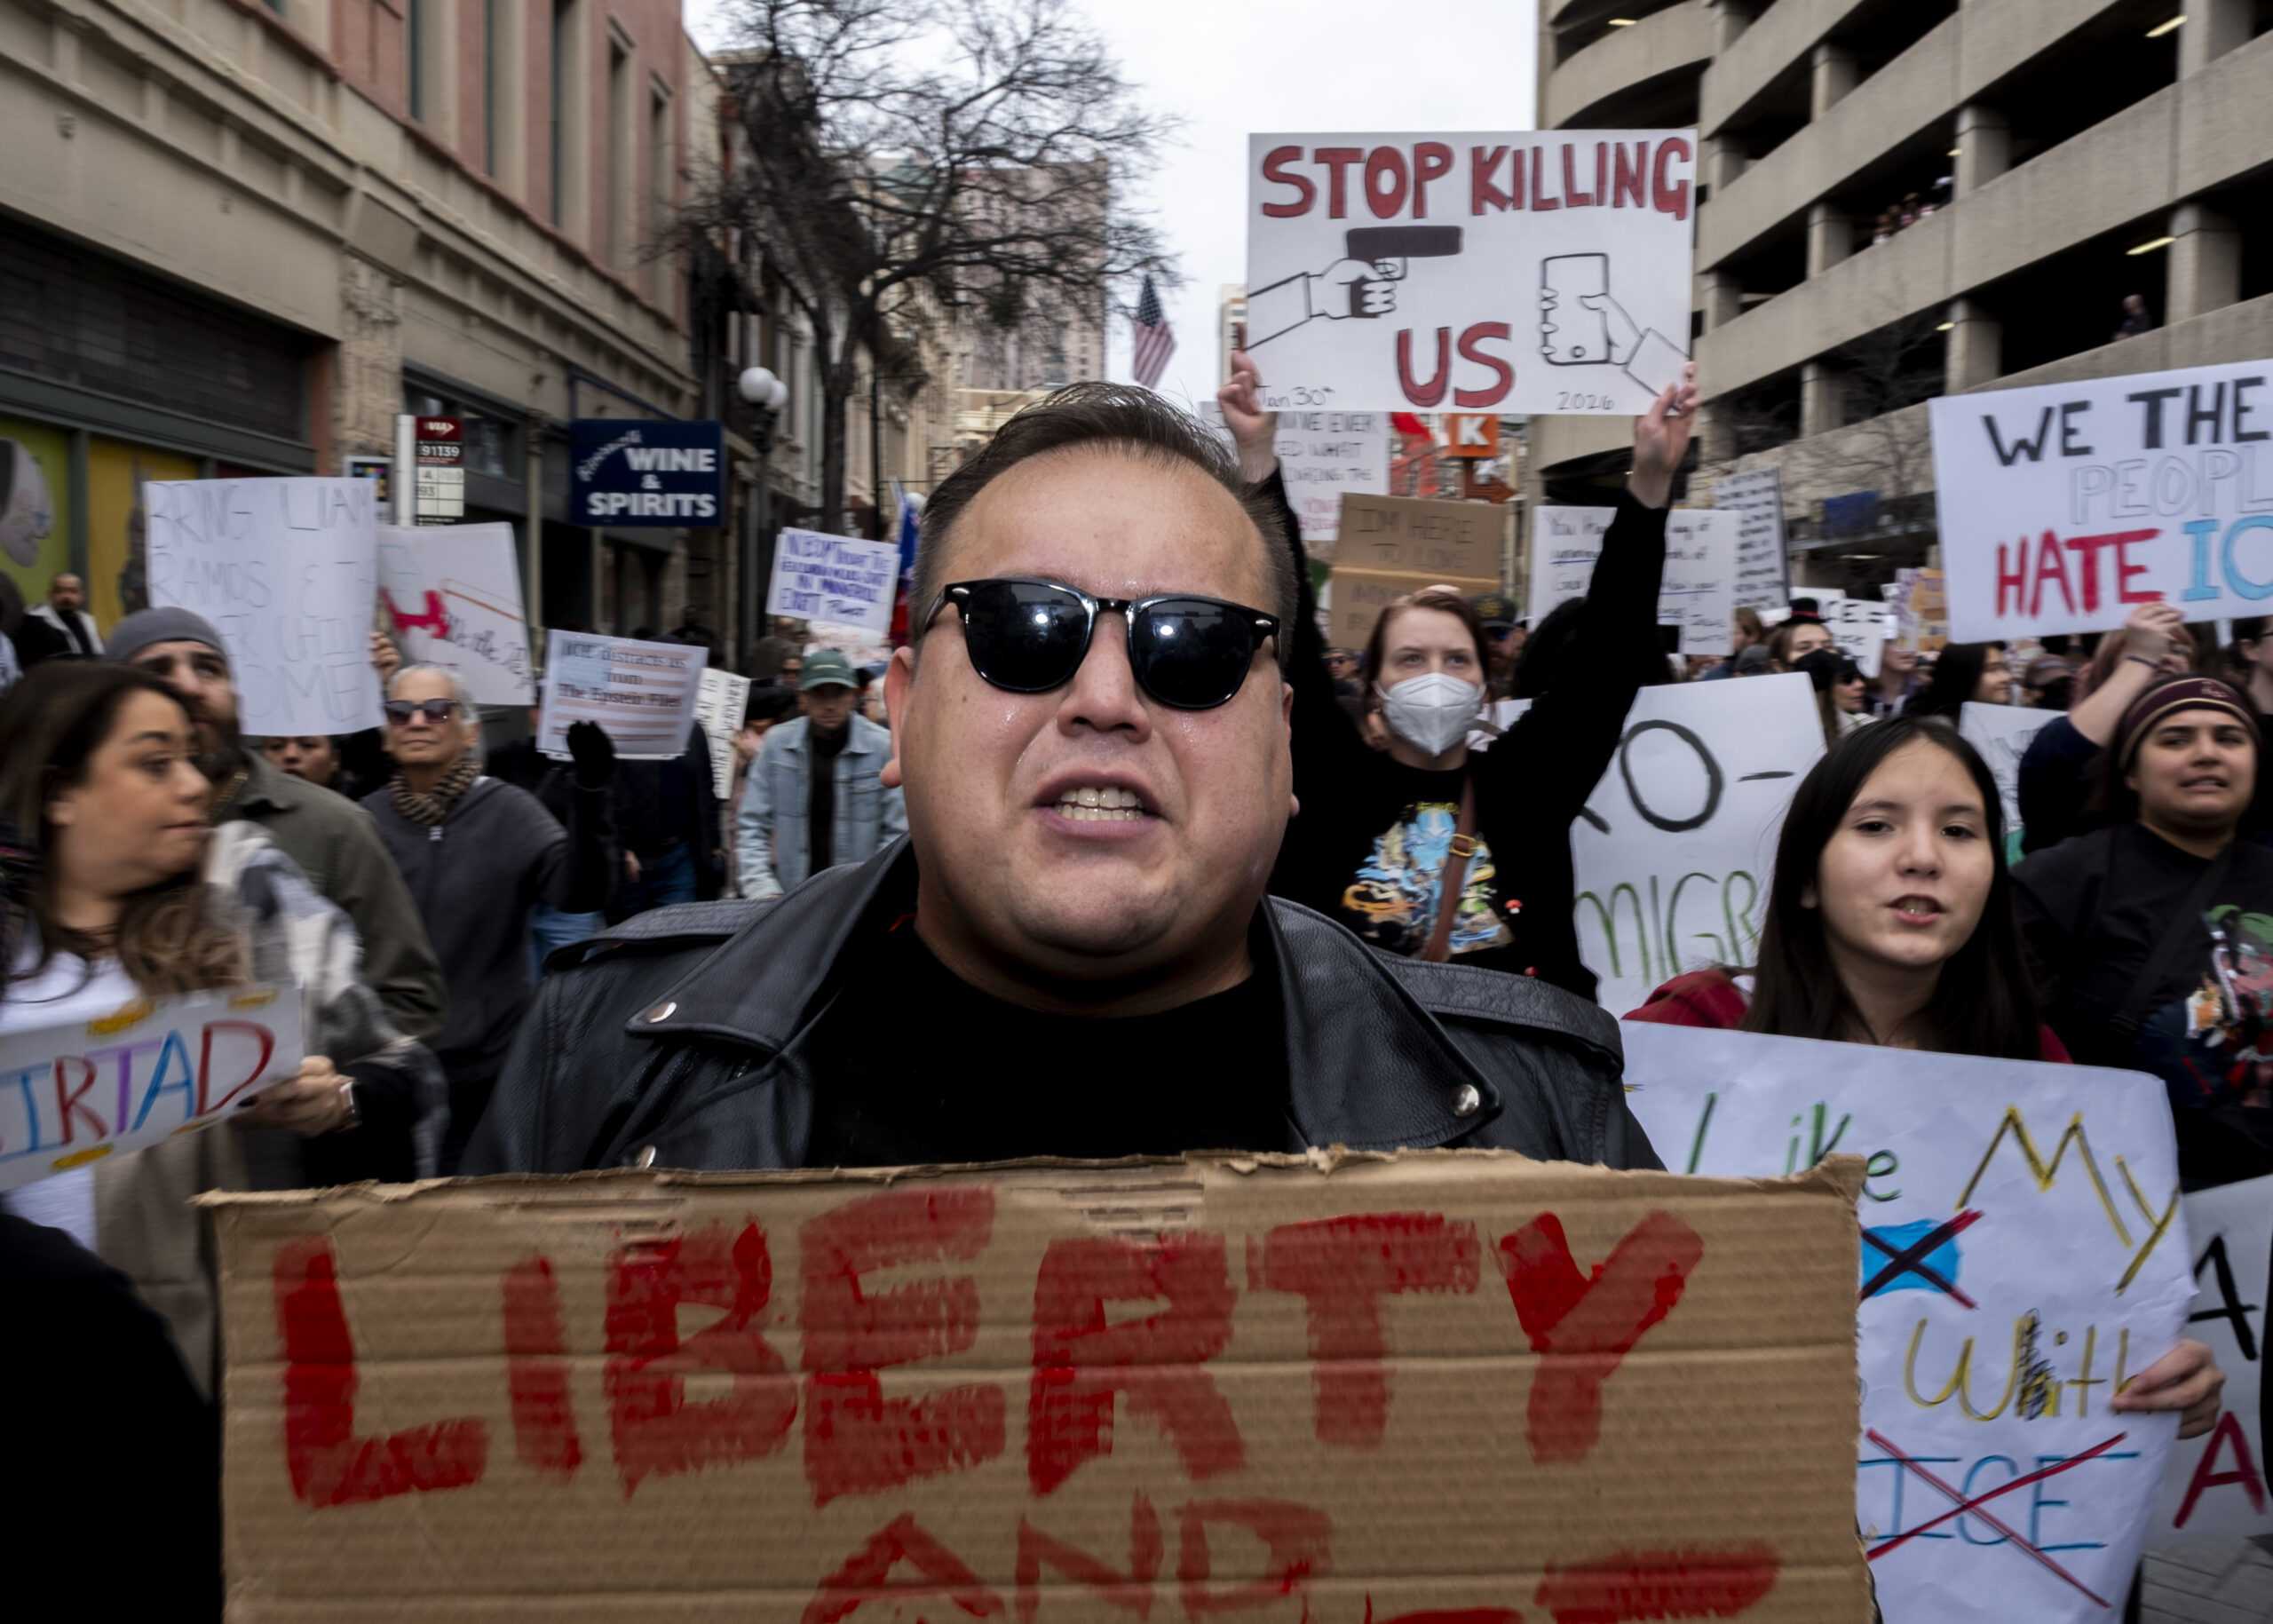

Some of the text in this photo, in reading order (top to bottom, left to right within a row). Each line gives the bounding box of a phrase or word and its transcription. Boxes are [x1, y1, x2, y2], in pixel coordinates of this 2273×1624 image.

[1262, 137, 1692, 220] STOP KILLING
[1397, 321, 1516, 408] US
[1556, 392, 1614, 411] 2026
[422, 446, 460, 456] 91139
[624, 448, 717, 471] WINE
[1459, 417, 1491, 445] K
[1982, 376, 2272, 467] WE THE
[587, 492, 717, 518] SPIRITS
[641, 474, 661, 489] &
[1995, 527, 2166, 619] HATE
[1955, 1104, 2182, 1298] My
[273, 1185, 1704, 1511] LIBERTY
[798, 1485, 1334, 1624] AND
